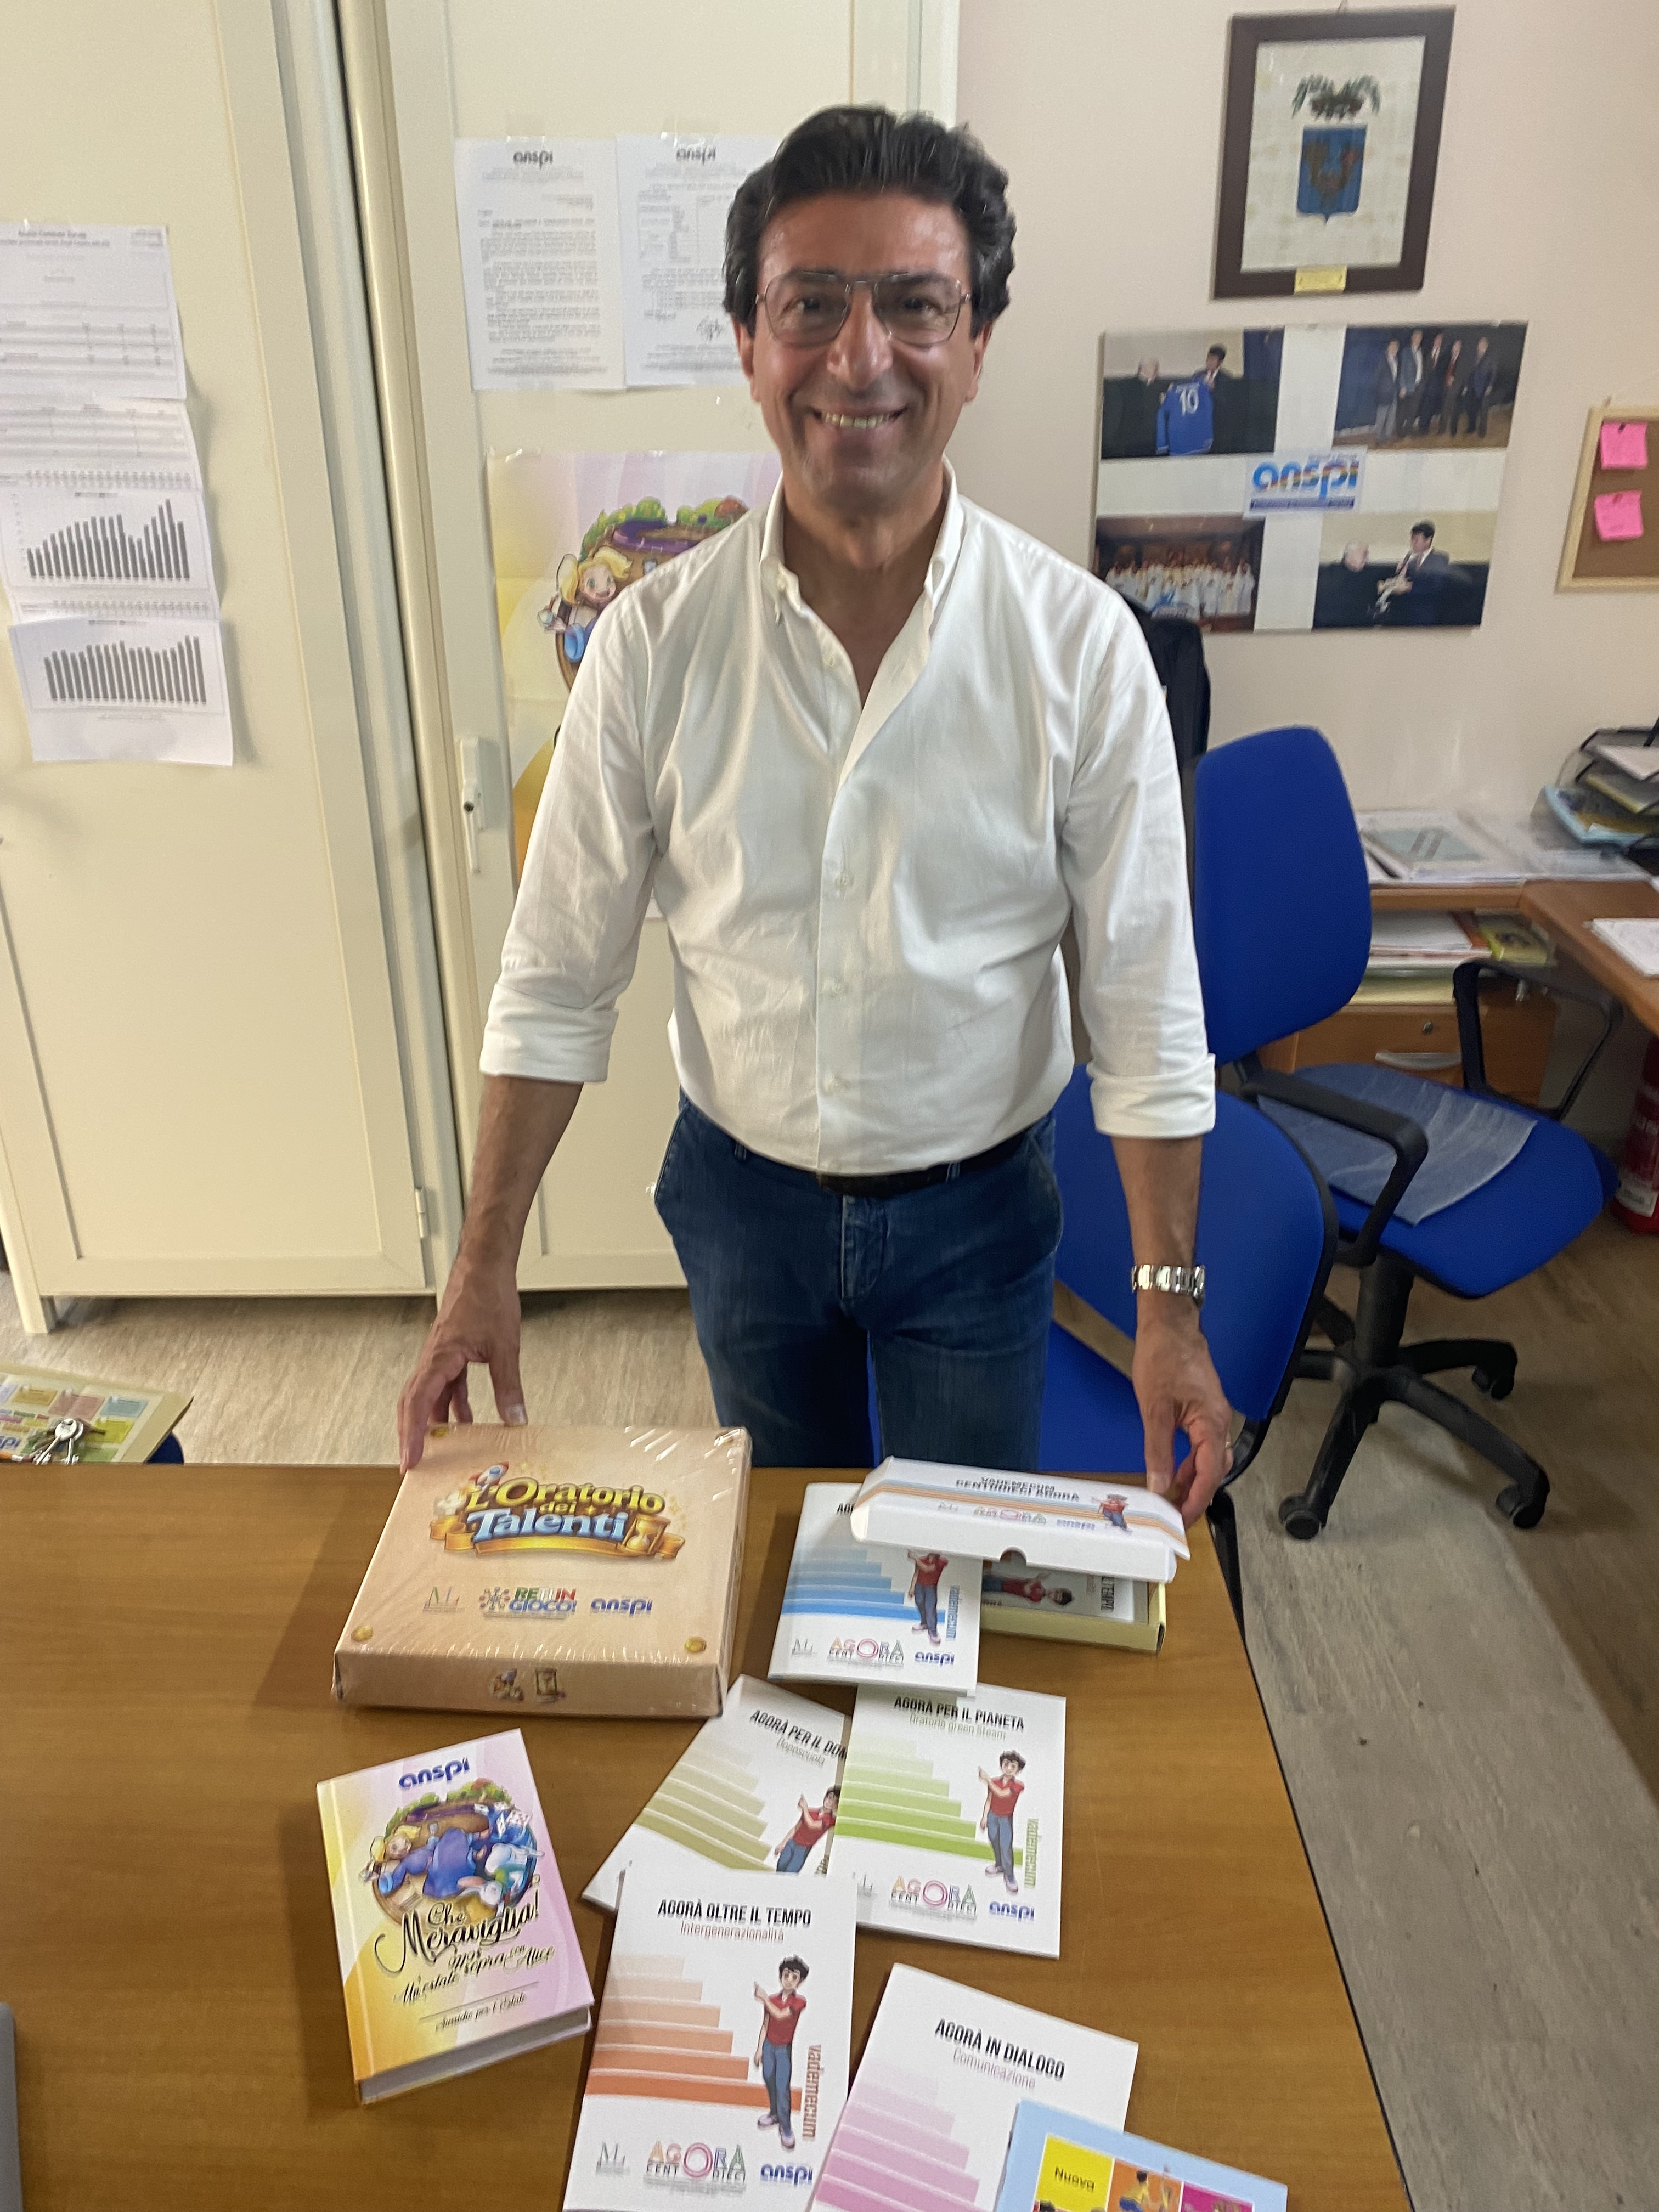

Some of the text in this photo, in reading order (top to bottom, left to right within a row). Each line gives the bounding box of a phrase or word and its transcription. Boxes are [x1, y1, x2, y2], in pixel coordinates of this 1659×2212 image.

[513, 150, 553, 169] anspi
[1180, 389, 1199, 415] 10
[1252, 460, 1359, 500] anspi
[466, 1477, 665, 1514] L'Oratorio
[539, 1500, 577, 1514] dei
[467, 1506, 629, 1544] Talenti
[591, 1595, 652, 1617] anspi
[915, 1651, 955, 1667] anspi
[936, 1702, 959, 1719] PER
[961, 1707, 973, 1723] IL
[974, 1709, 1024, 1733] PIANETA
[750, 1709, 848, 1760] AGORÀ PER IL DON
[399, 1757, 470, 1788] anspi
[428, 1902, 465, 1925] Che
[657, 1898, 811, 1928] AGORÀ OLTRE IL TEMPO
[989, 1901, 1035, 1922] anspi
[680, 1920, 785, 1944] Intergenerazionalità
[934, 2018, 1065, 2081] AGORÀ IN DIALOGO
[953, 2047, 1036, 2089] Comunicazione
[803, 2044, 821, 2137] vademecum
[760, 2164, 813, 2187] anspi
